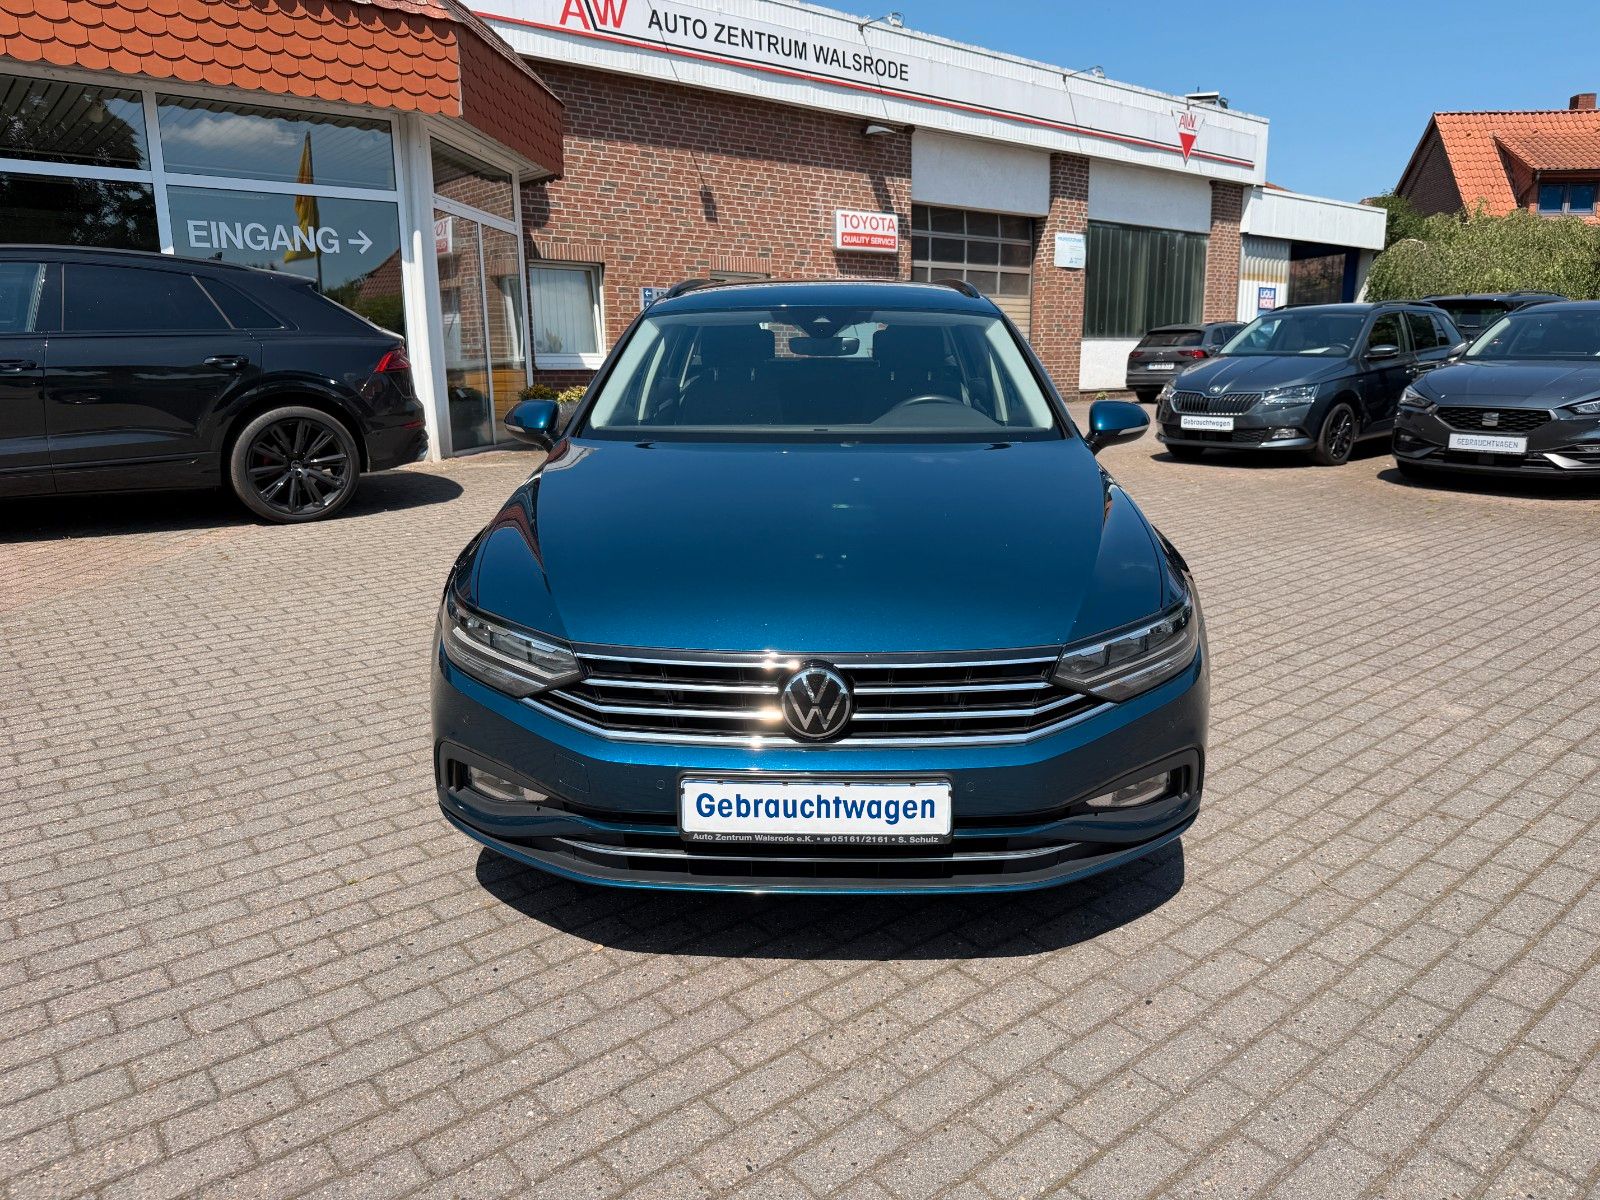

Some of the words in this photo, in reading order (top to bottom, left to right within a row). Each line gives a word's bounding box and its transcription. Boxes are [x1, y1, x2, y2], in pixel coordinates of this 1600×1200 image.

[648, 9, 708, 40] AUTO
[714, 23, 807, 61] ZENTRUM
[813, 44, 910, 82] WALSRODE
[841, 213, 896, 233] TOYOTA
[186, 219, 341, 254] EINGANG
[843, 235, 870, 245] QUALITY
[870, 236, 895, 247] SERVICE
[1183, 418, 1231, 427] Gebrauchtwagen
[1456, 438, 1519, 448] GEBRAUCHTWAGEN
[695, 792, 935, 826] Gebrauchtwagen
[692, 833, 713, 841] Auto
[715, 833, 752, 841] Zentrum
[754, 834, 795, 842] Walsrode
